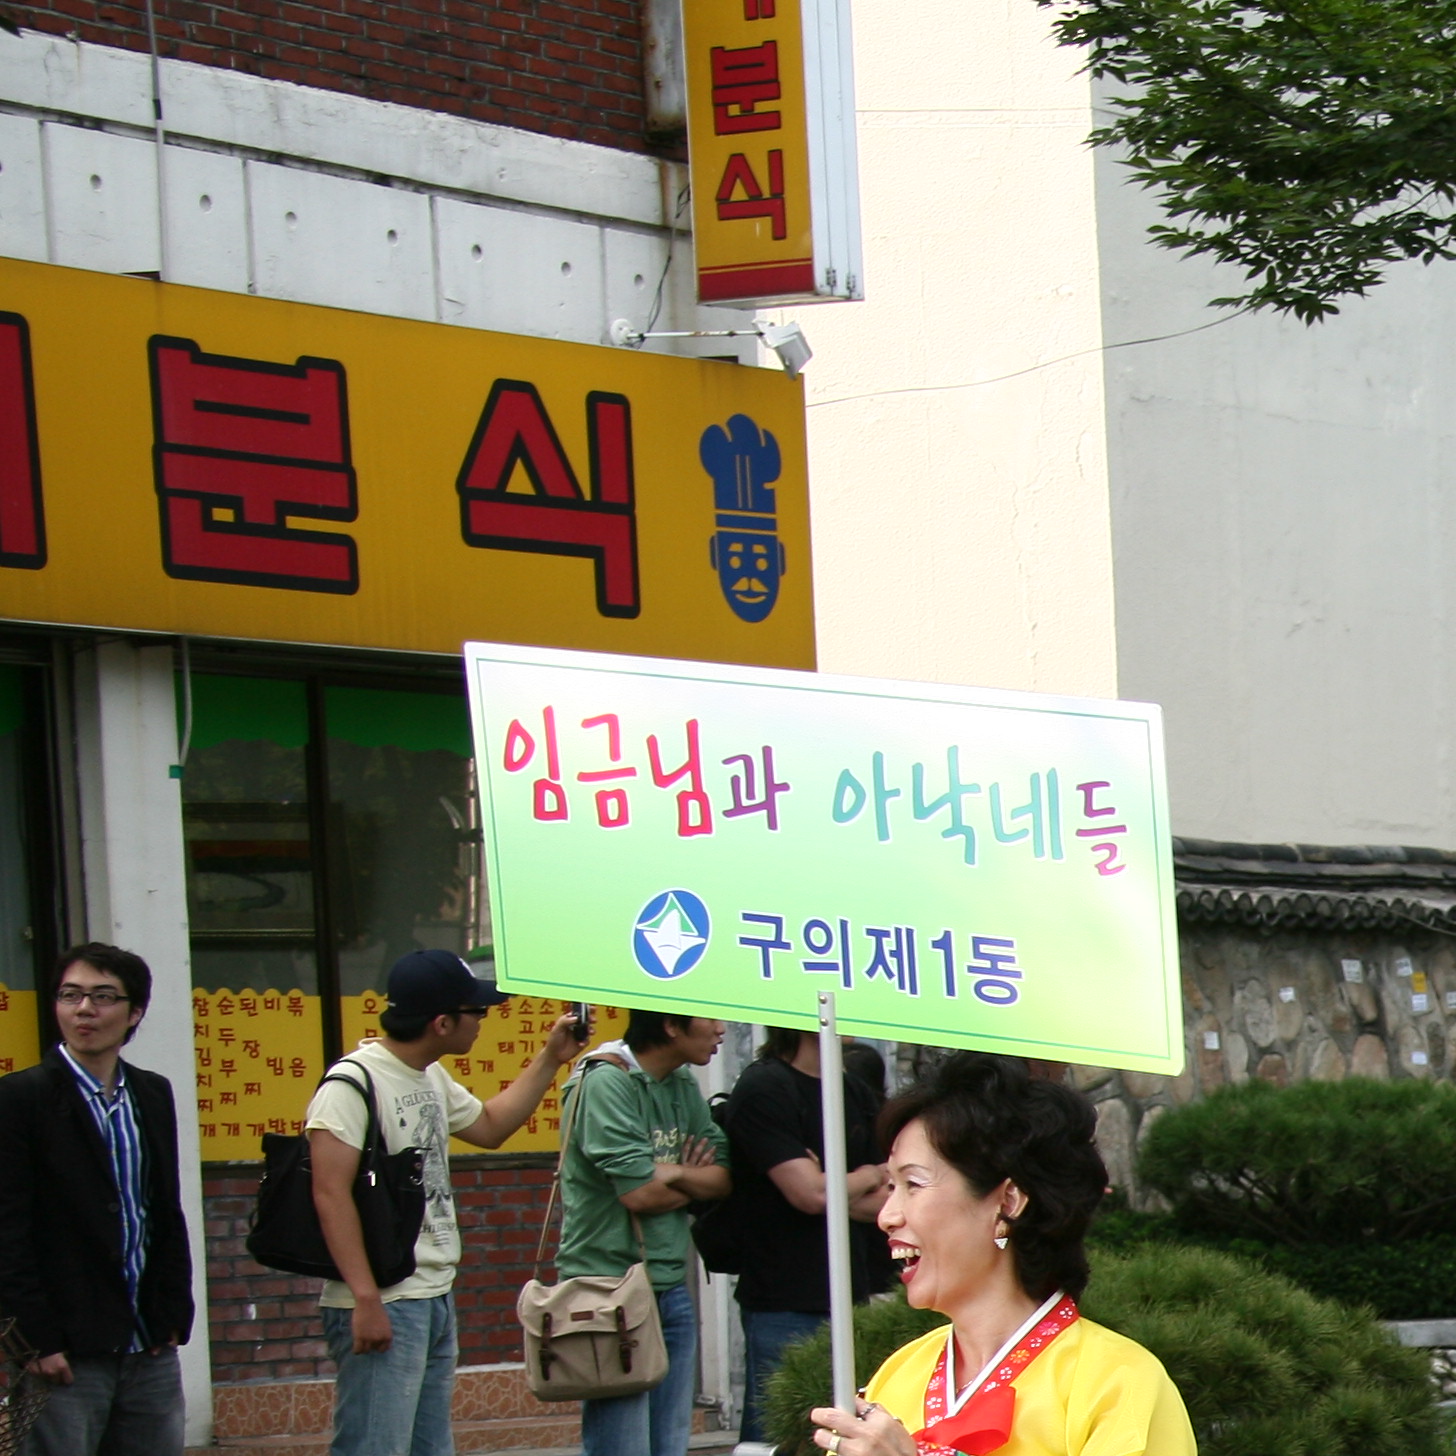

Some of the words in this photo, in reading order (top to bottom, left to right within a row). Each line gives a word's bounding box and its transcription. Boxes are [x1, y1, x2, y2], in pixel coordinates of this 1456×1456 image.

[503, 705, 792, 837] 임금님과
[831, 745, 1129, 876] 아낙네들
[737, 911, 1024, 1006] 구의제1동
